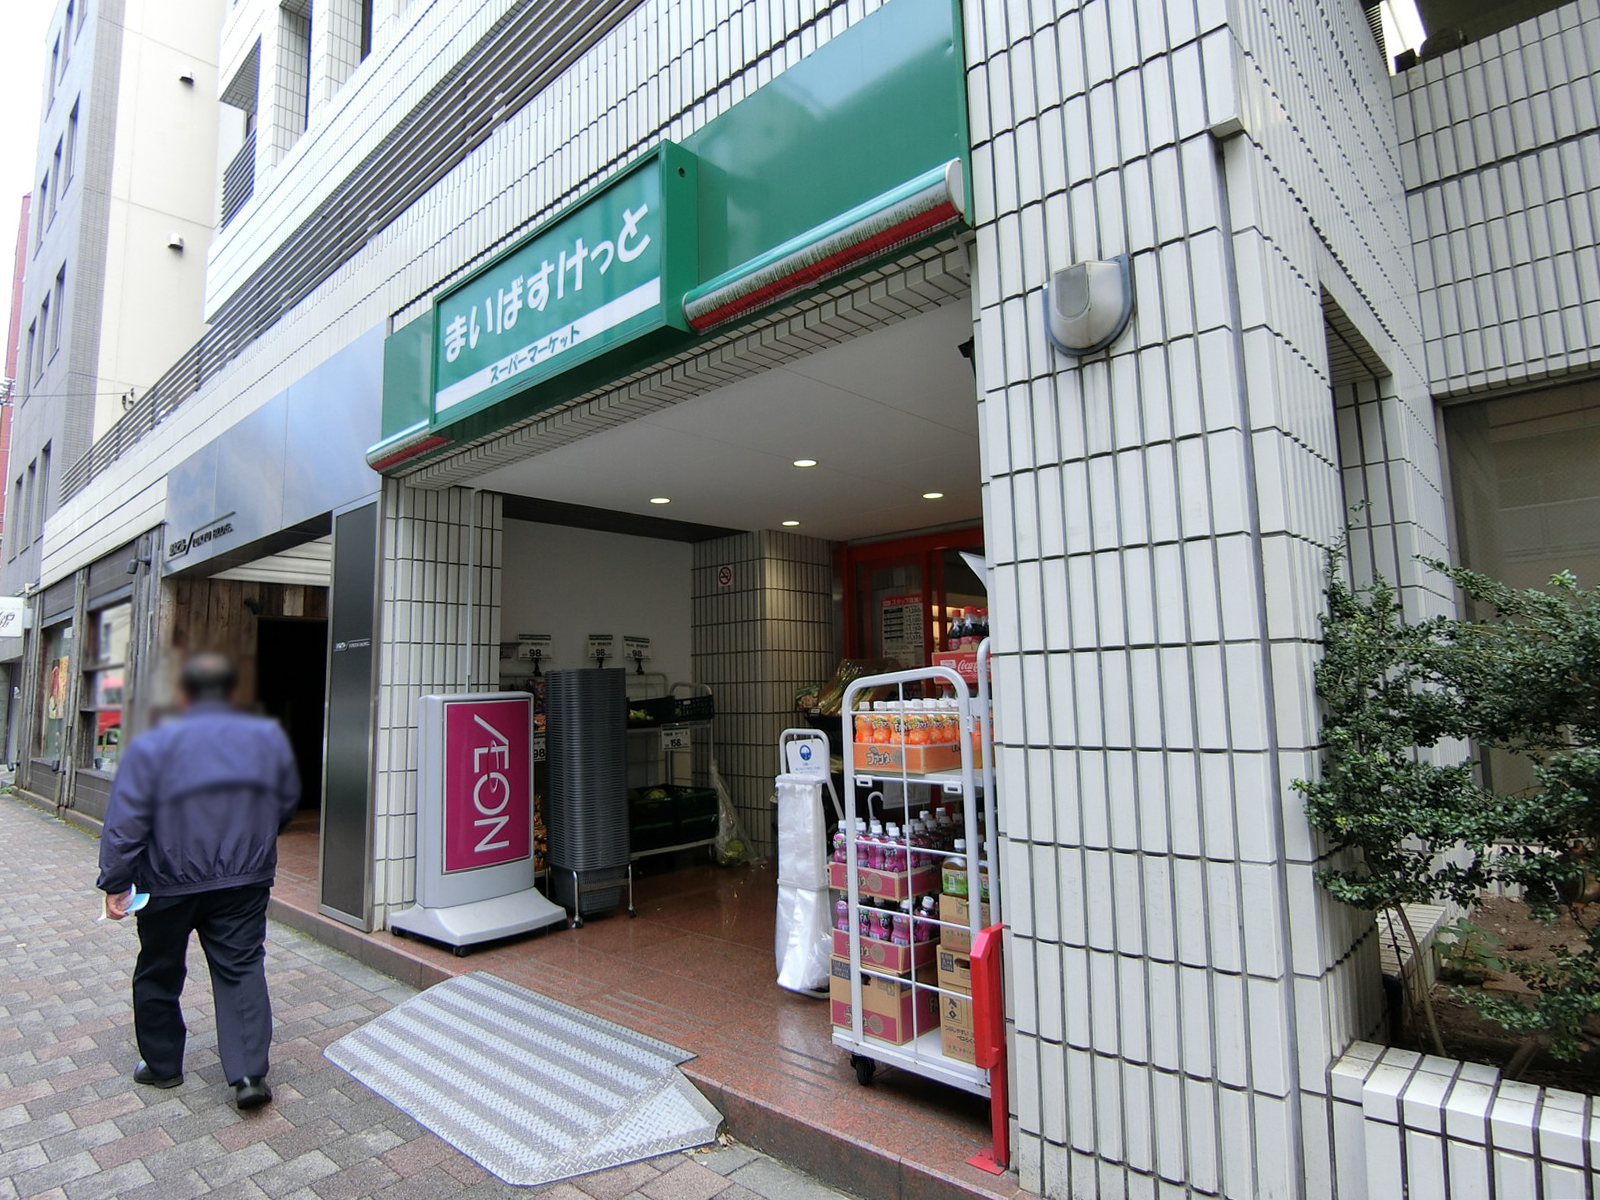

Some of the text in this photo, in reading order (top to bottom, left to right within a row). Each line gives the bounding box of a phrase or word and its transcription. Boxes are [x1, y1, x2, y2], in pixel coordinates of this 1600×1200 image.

[444, 203, 651, 363] まいばすけっと
[490, 325, 580, 384] スーパーマーケット
[529, 648, 542, 657] 98
[595, 648, 606, 657] 98
